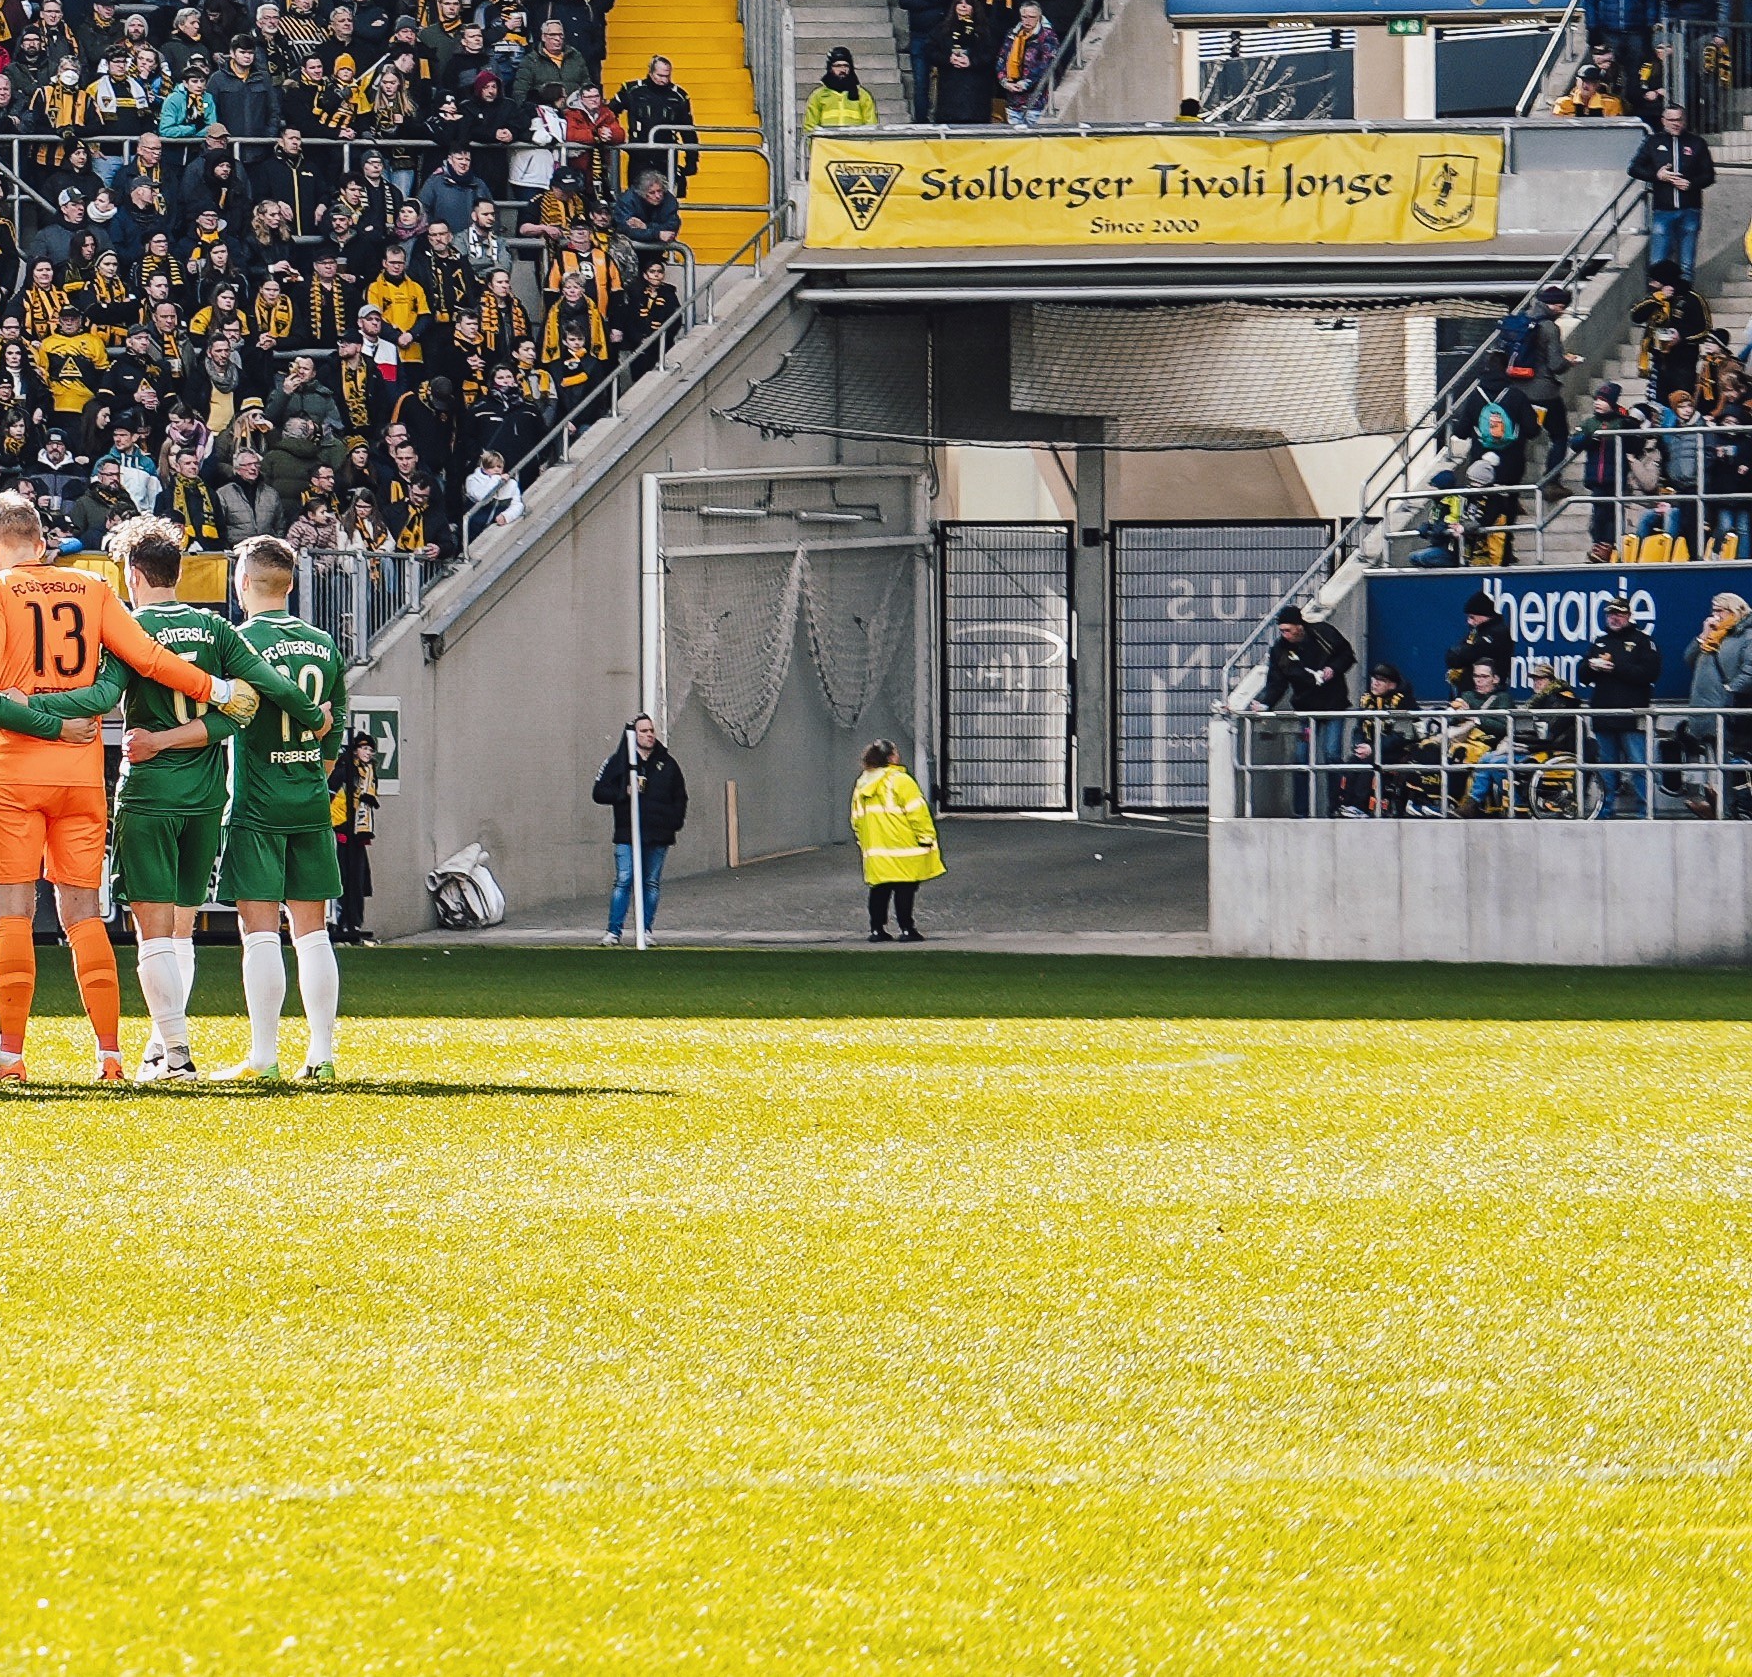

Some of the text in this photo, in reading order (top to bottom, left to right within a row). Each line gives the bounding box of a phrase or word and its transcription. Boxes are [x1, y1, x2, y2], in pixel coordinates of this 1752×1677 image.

[920, 162, 1393, 208] Stolberger Tivoli Jonge
[1090, 216, 1199, 234] Since 2000
[11, 580, 27, 598] FC
[25, 600, 86, 678] 13
[1510, 646, 1595, 689] ntrum
